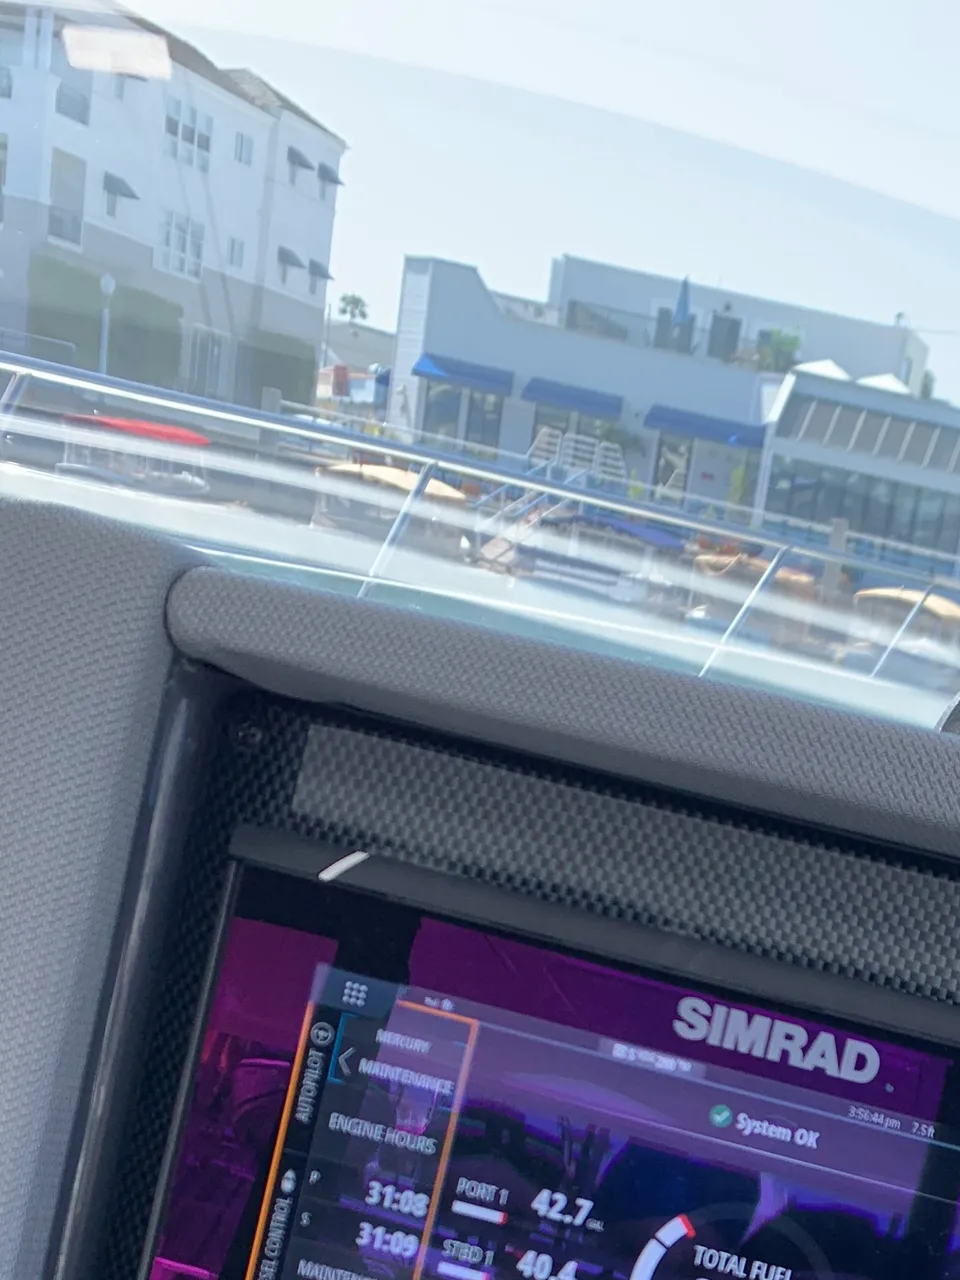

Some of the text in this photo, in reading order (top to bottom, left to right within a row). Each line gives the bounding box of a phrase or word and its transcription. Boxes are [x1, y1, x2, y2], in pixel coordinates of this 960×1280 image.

[376, 1028, 431, 1054] MERCURY
[672, 996, 881, 1084] SIMRAD
[295, 1048, 326, 1124] AUTOPILOT
[358, 1058, 455, 1095] MAINTENANCE
[329, 1112, 438, 1155] ENGINE HOURS
[735, 1112, 820, 1149] System OK
[456, 1177, 499, 1203] PORT
[531, 1188, 594, 1226] 42.7
[263, 1197, 293, 1259] CONTROL
[693, 1244, 748, 1280] TOTAL
